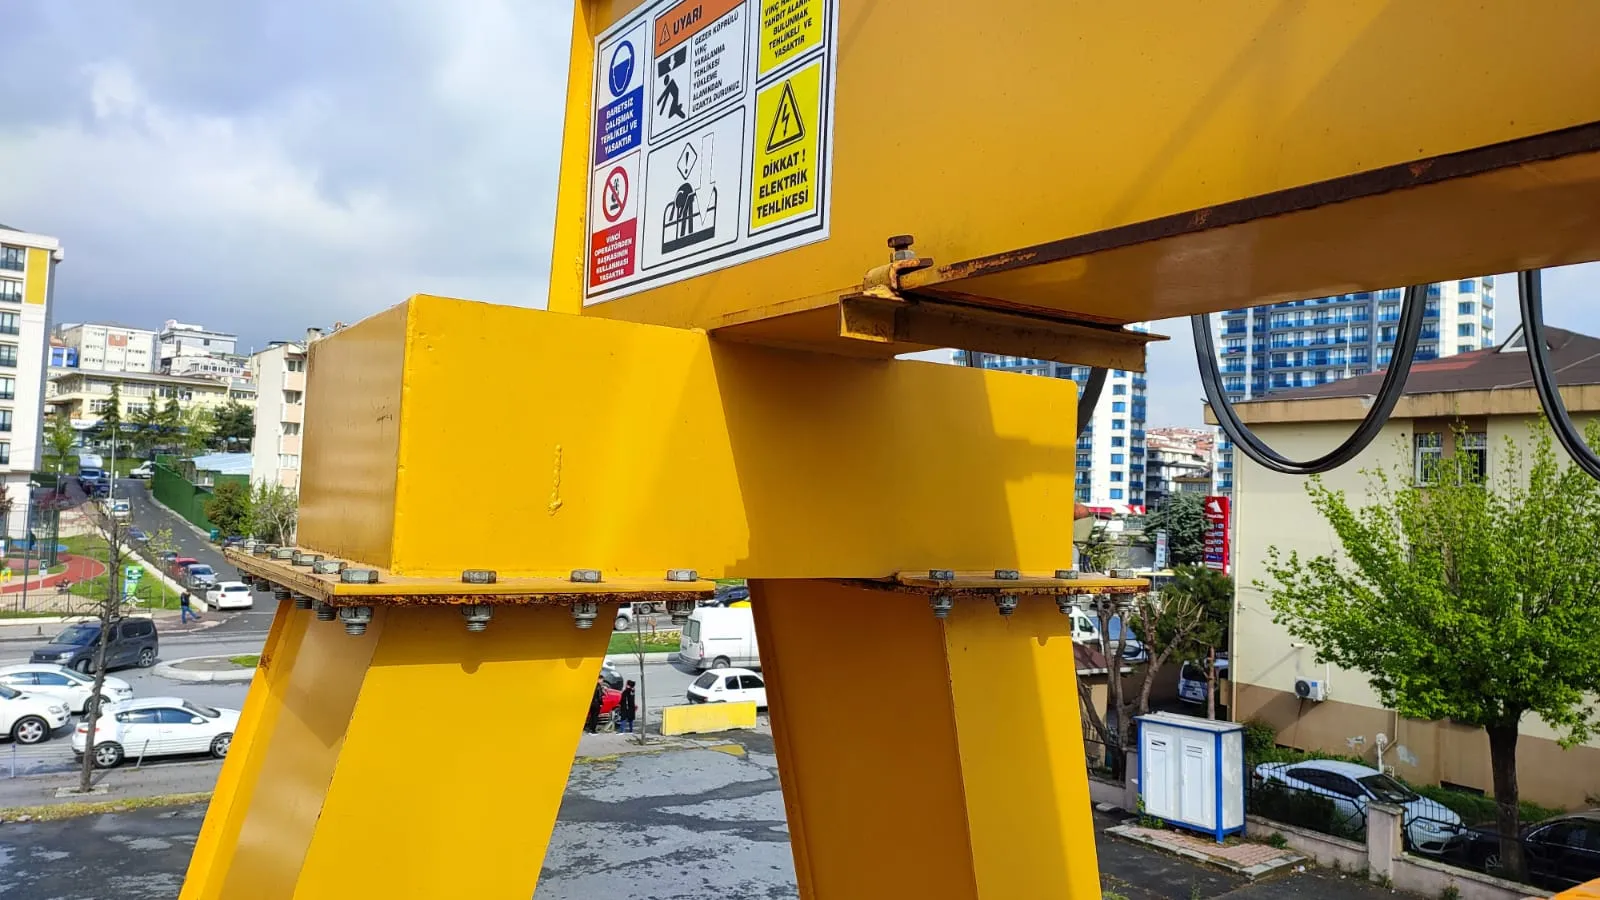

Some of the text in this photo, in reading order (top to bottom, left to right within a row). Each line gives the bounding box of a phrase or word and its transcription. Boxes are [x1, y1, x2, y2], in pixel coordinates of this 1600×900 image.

[673, 5, 702, 35] UYARI
[773, 7, 808, 35] BULUNMAK
[694, 29, 712, 45] GEZER
[769, 17, 812, 49] TEHLİKELİ VE
[694, 43, 725, 68] YARALANMA
[774, 35, 805, 58] YASAKTIR
[692, 80, 740, 112] UZAKTA DURUNUZ
[693, 78, 723, 101] ALANINDAN
[606, 97, 634, 119] BARETSİZ
[605, 109, 634, 133] ÇALIŞMAK
[630, 119, 638, 130] VE
[604, 134, 632, 154] YASAKTIR
[763, 151, 800, 178] DİKKAT
[759, 168, 808, 199] ELEKTRİK
[757, 185, 808, 219] TEHLİKESİ
[599, 269, 625, 281] YASAKTIR
